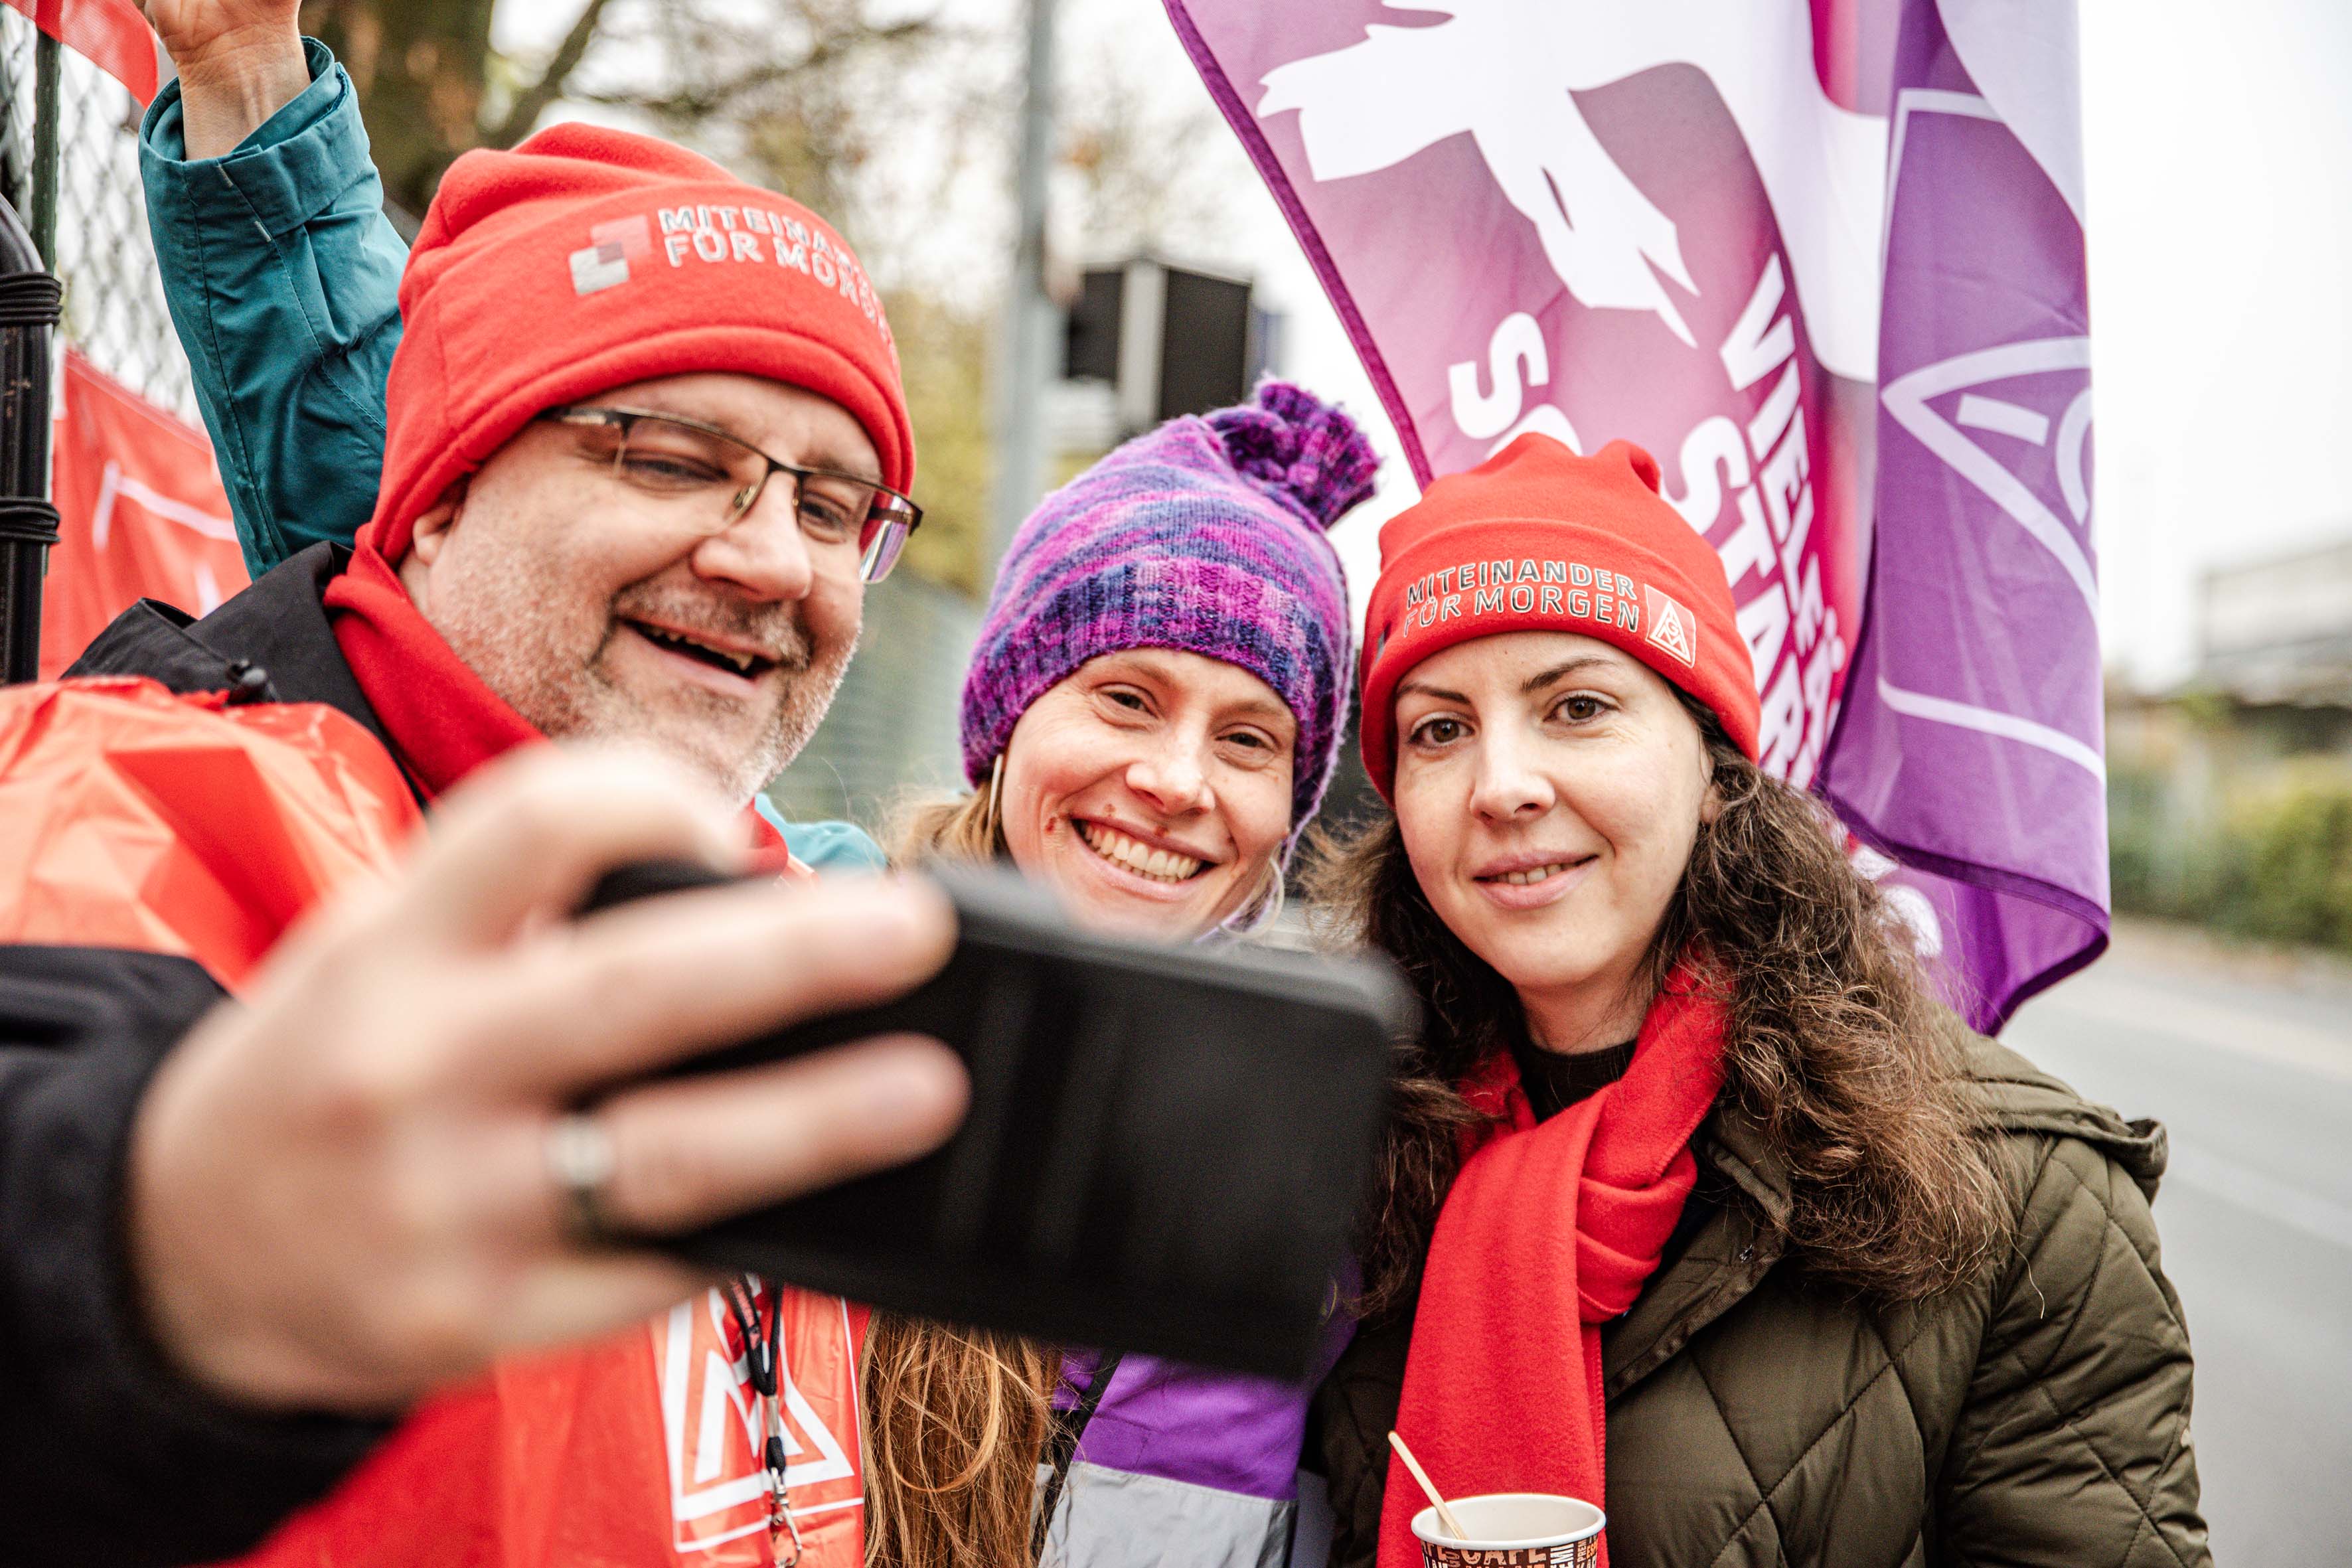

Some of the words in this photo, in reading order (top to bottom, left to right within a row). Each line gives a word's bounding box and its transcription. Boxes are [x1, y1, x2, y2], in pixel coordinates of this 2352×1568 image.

[1407, 559, 1638, 611] MITEINANDER
[1660, 416, 1816, 789] STAR
[1403, 595, 1462, 637] FÜR
[1474, 586, 1639, 633] MORGEN
